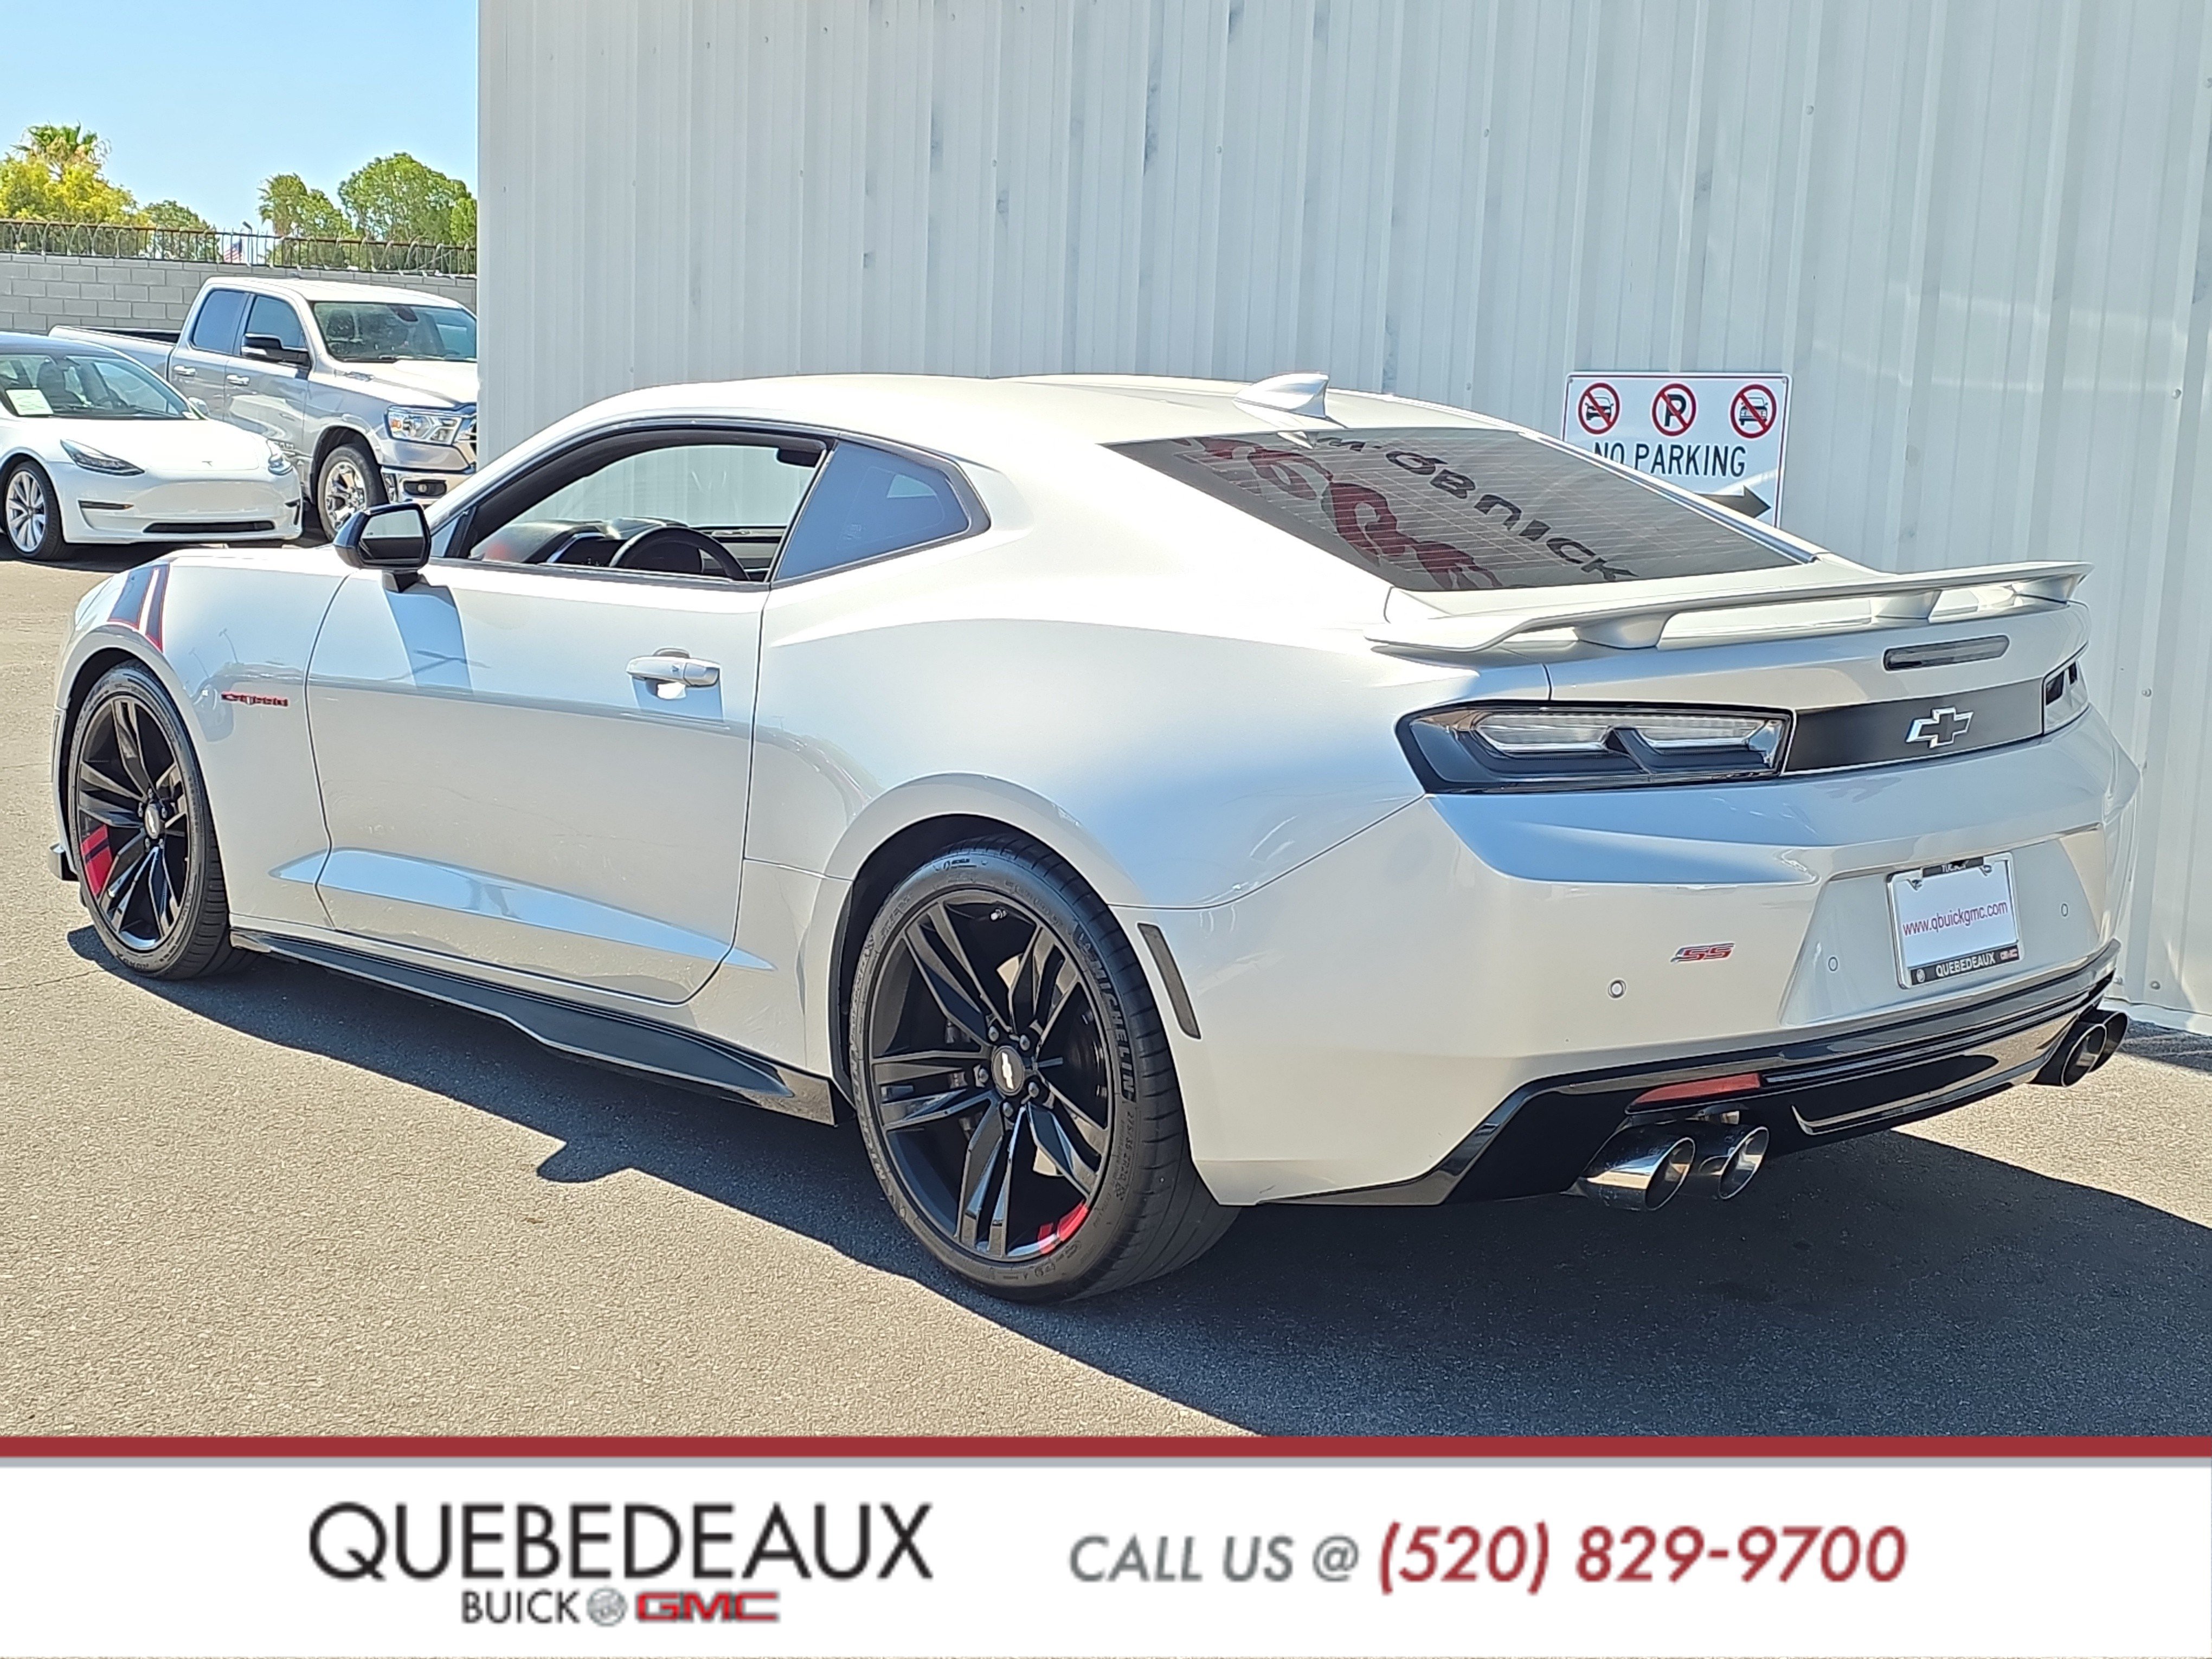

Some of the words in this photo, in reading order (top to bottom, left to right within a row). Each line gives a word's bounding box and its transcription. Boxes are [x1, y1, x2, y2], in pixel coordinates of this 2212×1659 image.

[1594, 442, 1624, 465] NO
[1634, 443, 1746, 477] PARKING
[1902, 902, 2008, 936] www.qbuickgmc.com
[1673, 943, 1734, 962] SS
[1935, 952, 1996, 977] QUEBEDEAUX
[1090, 960, 1135, 1094] MICHELIN
